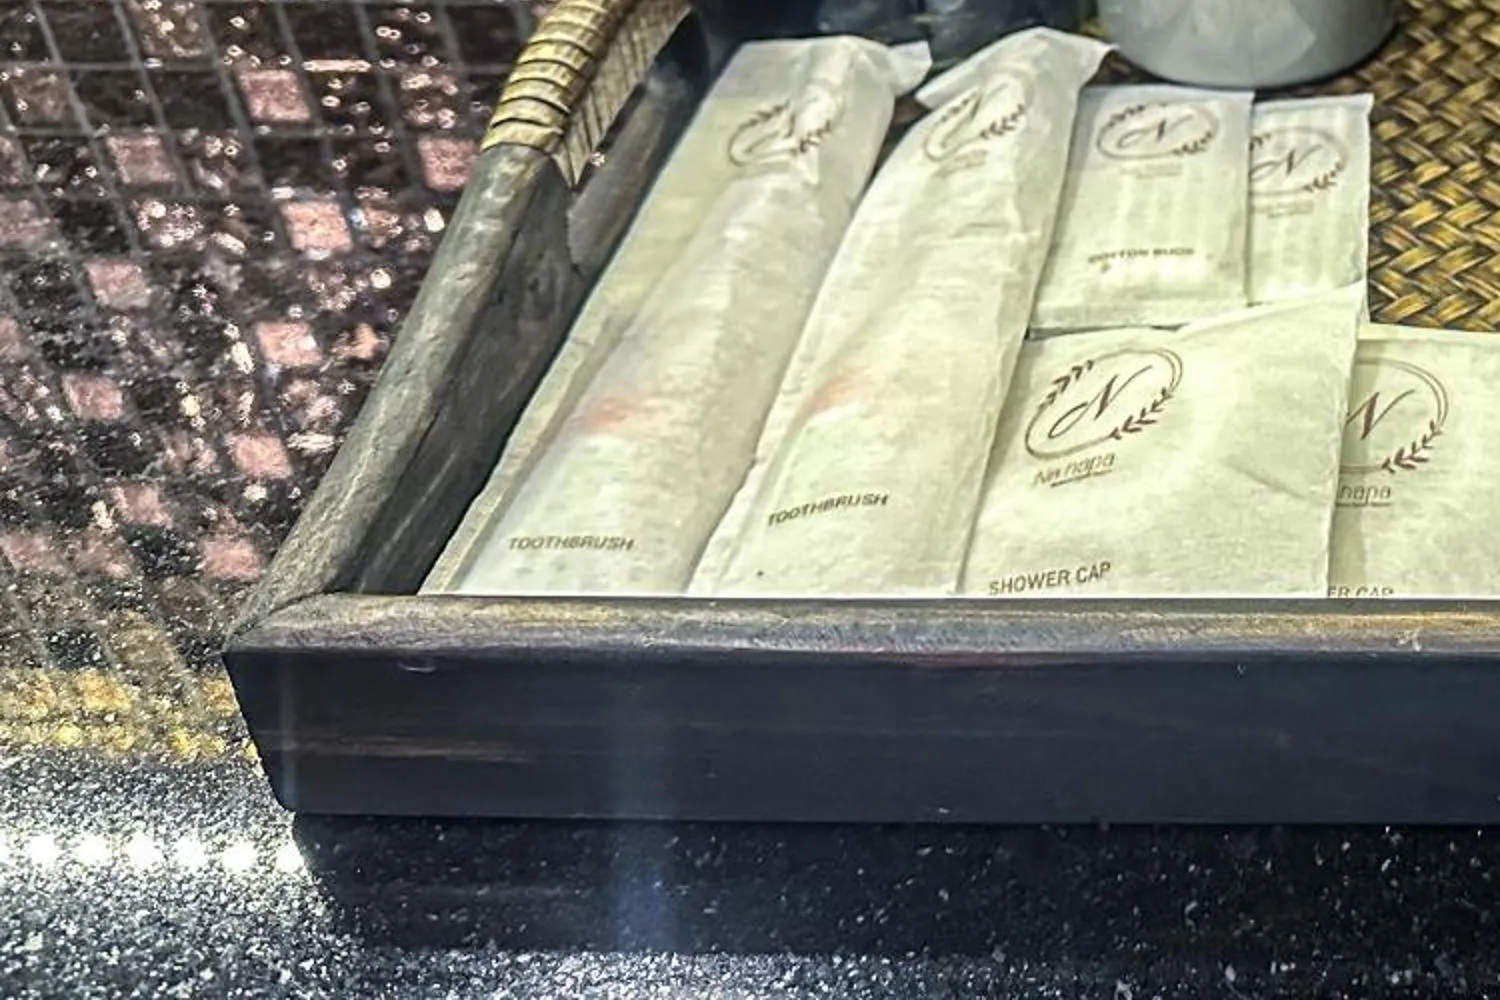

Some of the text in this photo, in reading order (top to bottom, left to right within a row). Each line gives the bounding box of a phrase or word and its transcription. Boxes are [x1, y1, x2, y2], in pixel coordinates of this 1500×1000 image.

[1047, 364, 1153, 439] N
[768, 493, 889, 526] TOOTHBRUSH
[509, 535, 635, 551] TOOTHBRUSH
[989, 560, 1111, 595] SHOWER CAP
